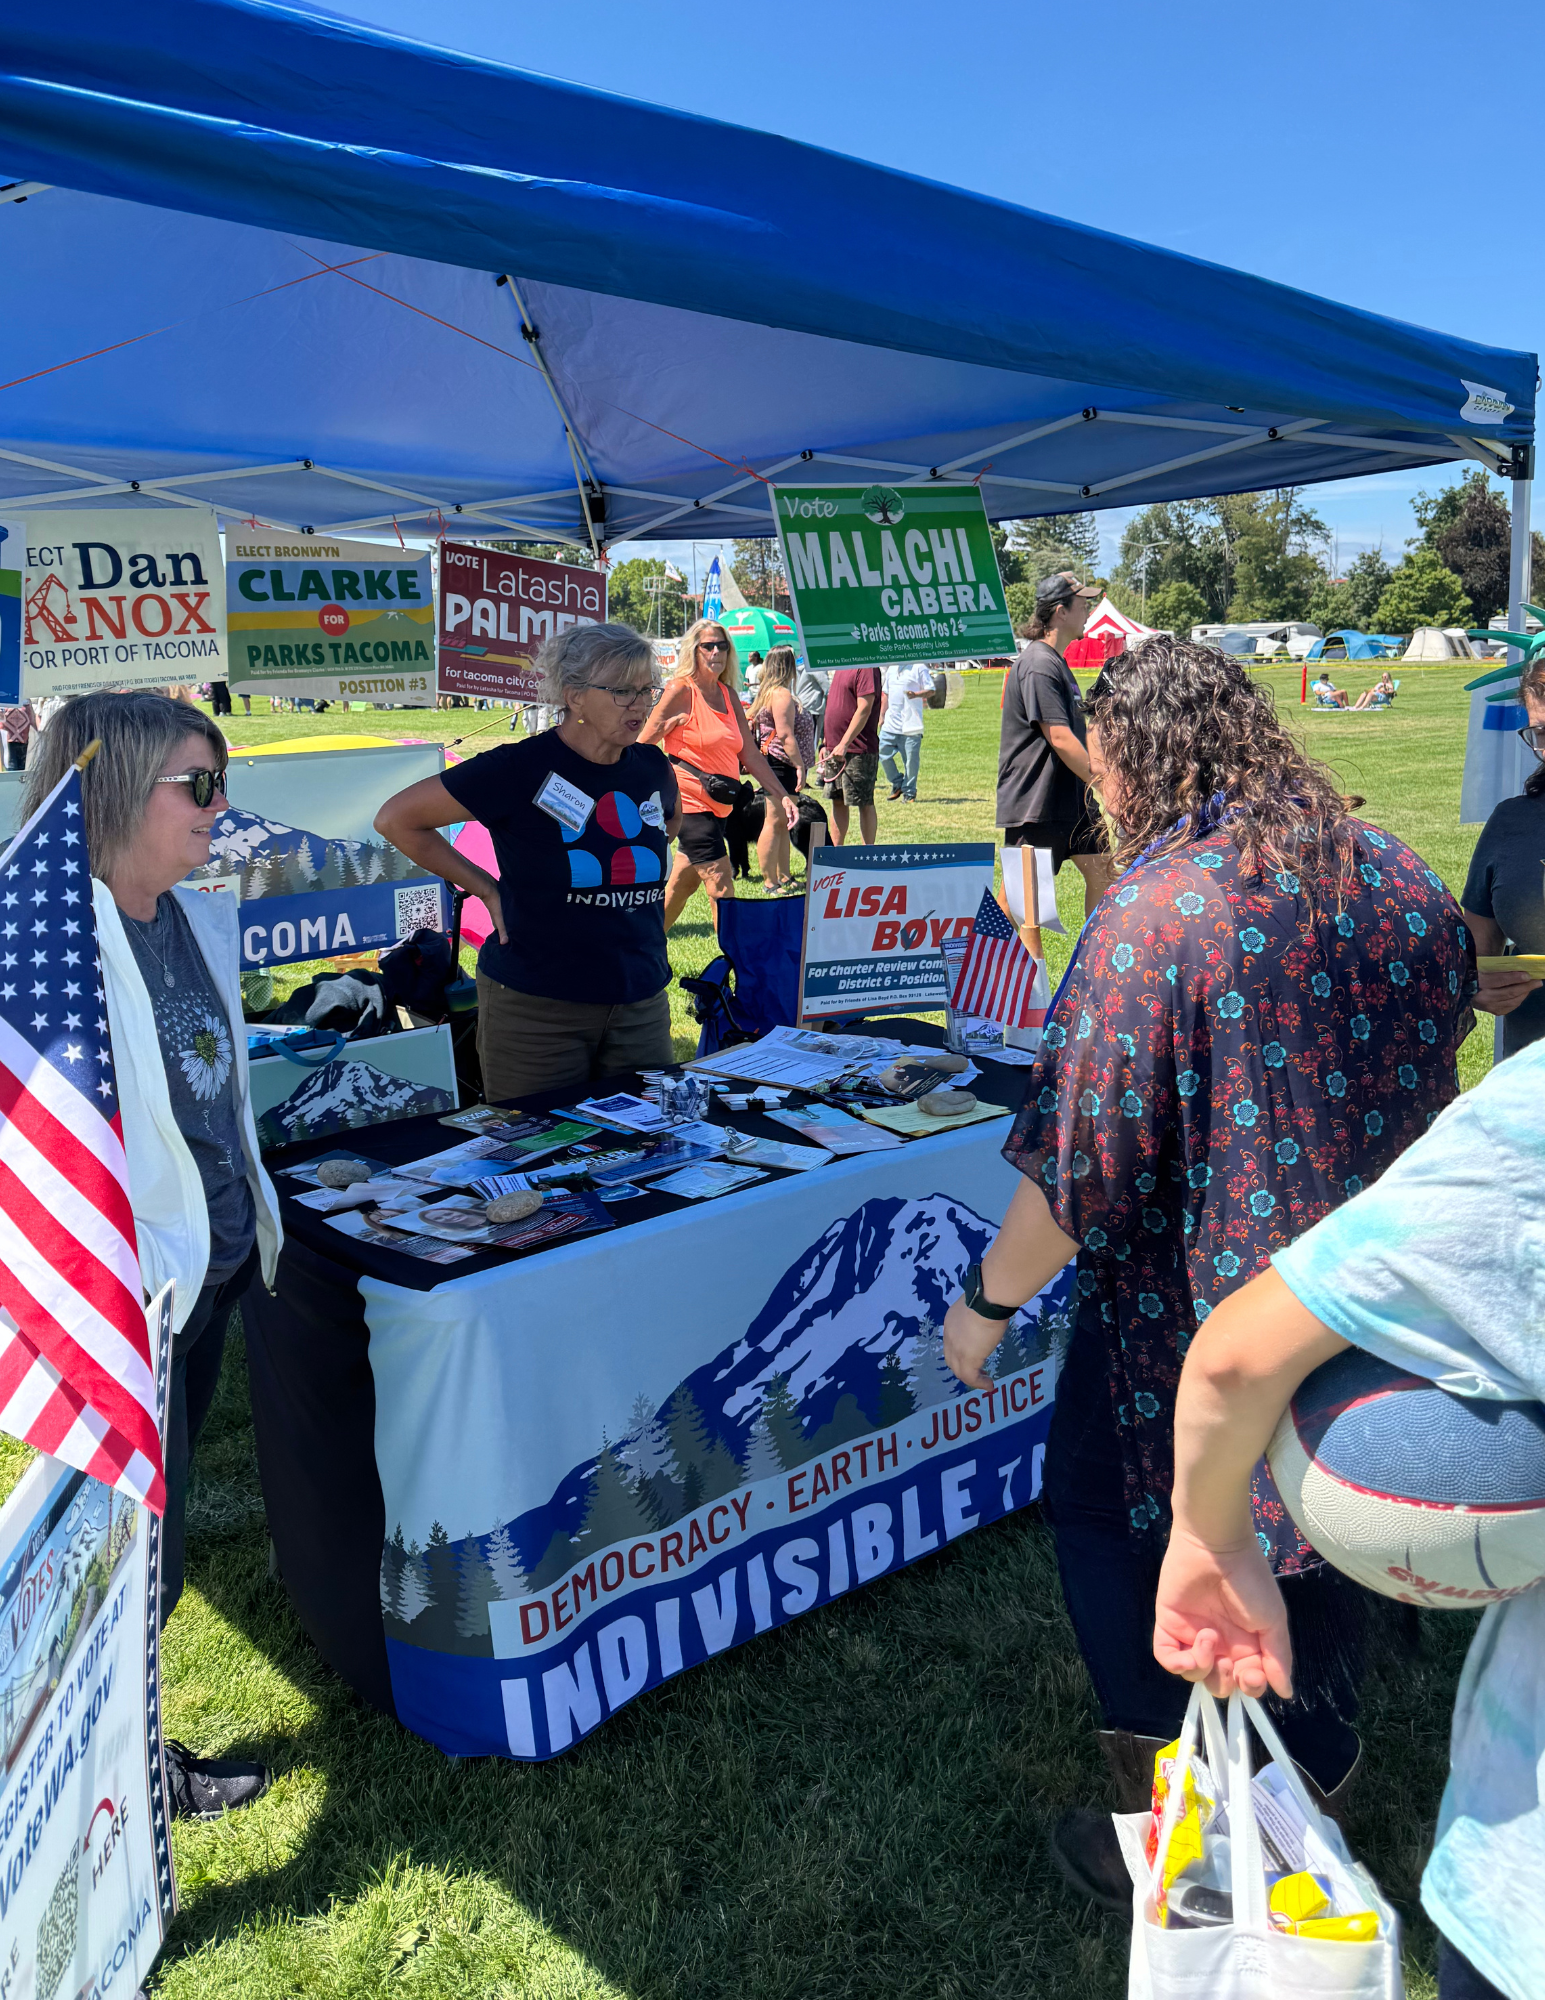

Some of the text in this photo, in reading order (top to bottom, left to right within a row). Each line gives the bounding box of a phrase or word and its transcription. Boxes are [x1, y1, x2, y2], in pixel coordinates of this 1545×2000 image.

[783, 496, 839, 519] Vote
[26, 542, 208, 590] ECT Dan
[235, 545, 340, 558] ELECT BRONWYN
[446, 551, 479, 569] VOTE
[786, 528, 977, 590] MALACHI
[238, 569, 421, 602] CLARKE
[482, 558, 600, 611] Latasha
[881, 583, 998, 617] CABERA
[324, 615, 344, 625] FOR
[861, 618, 958, 643] Parks Tacoma Pos 2
[24, 639, 220, 670] OR PORT OF TACOMA
[247, 640, 429, 668] PARKS TACOMA
[879, 644, 893, 652] Safe
[913, 641, 934, 651] Healthy
[935, 640, 949, 649] Lives
[339, 677, 427, 695] POSITION #3
[446, 666, 539, 688] for tacoma city co
[552, 782, 586, 810] Sharon
[813, 871, 847, 892] VOTE
[567, 888, 665, 907] INDIVISIBL
[823, 885, 907, 919] LISA
[243, 912, 356, 962] COMA
[808, 964, 827, 979] For
[829, 962, 875, 977] Charter
[876, 960, 917, 973] Review
[918, 959, 943, 970] Com
[838, 974, 881, 990] District
[883, 976, 891, 986] 6
[519, 1368, 1045, 1645] DEMOCRACY EARTH JUSTICE
[10, 1532, 54, 1652] VOTES
[501, 1458, 981, 1757] INDIVISIBLE
[0, 1582, 127, 1853] GISTER TO VOTE AT
[0, 1662, 113, 1922] VoteWA.gov
[92, 1796, 129, 1892] HERE
